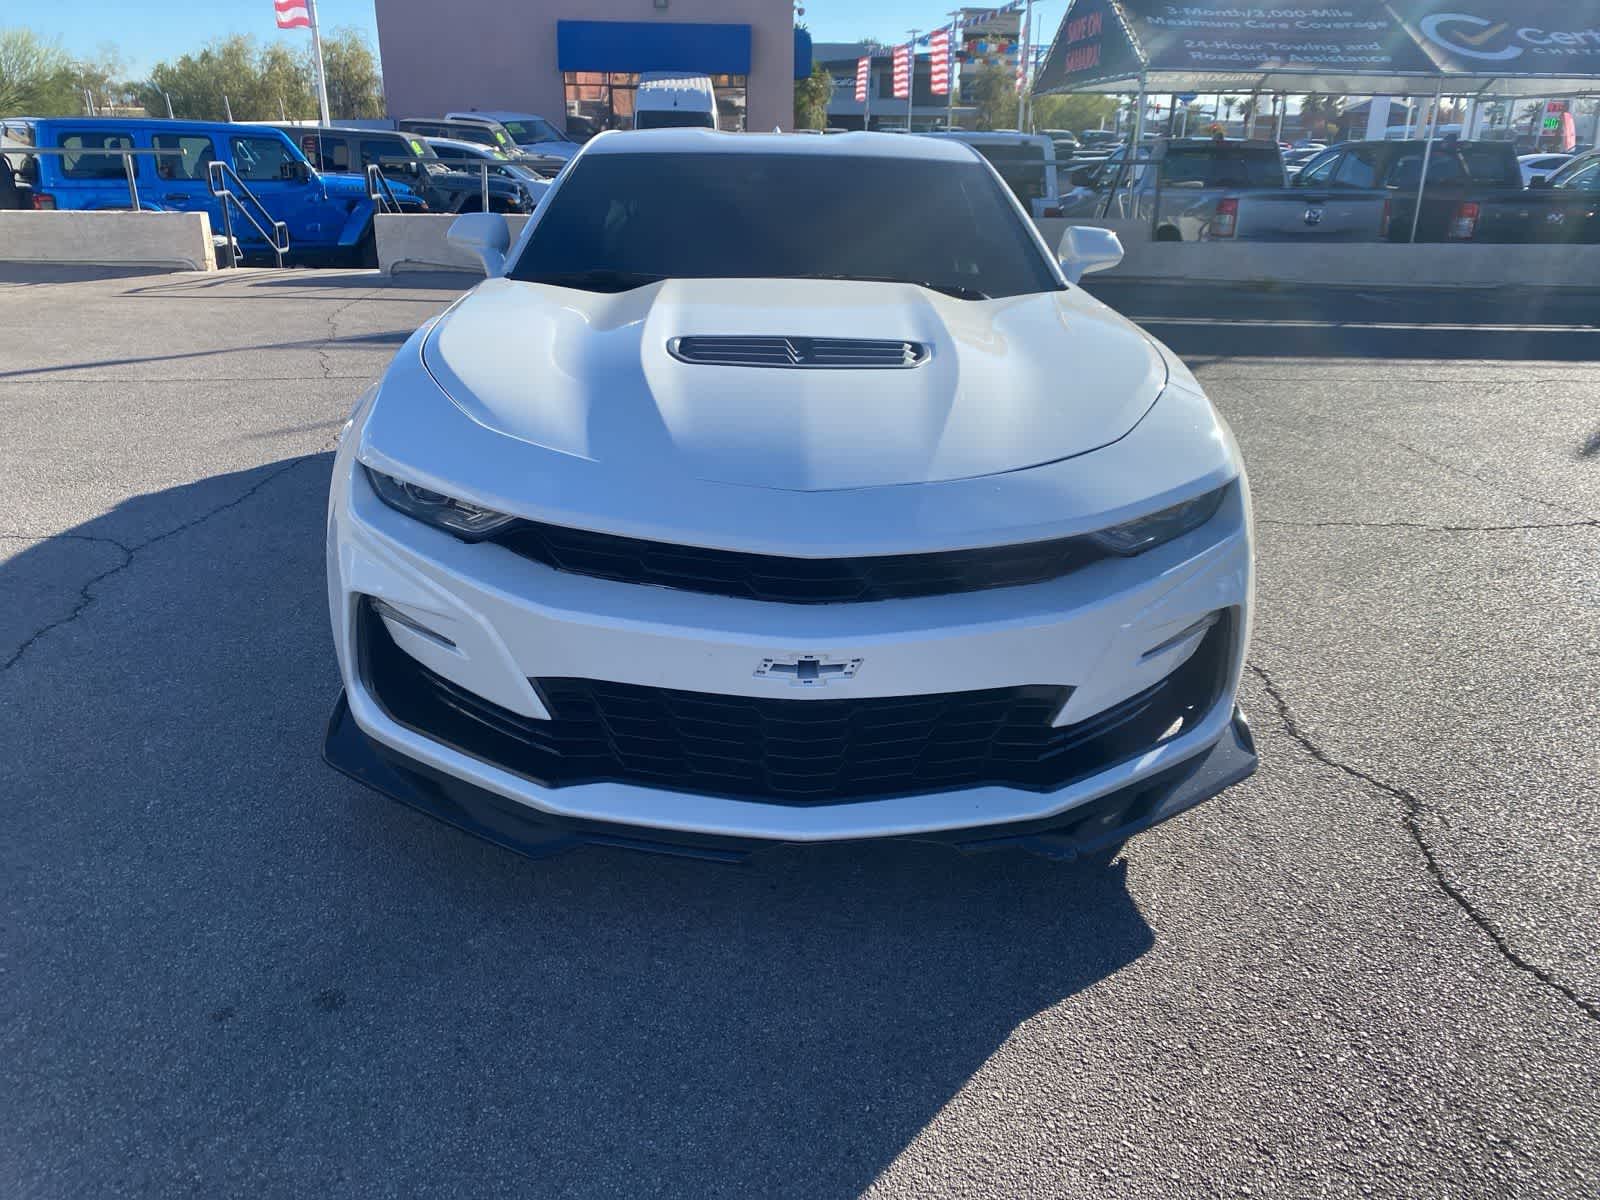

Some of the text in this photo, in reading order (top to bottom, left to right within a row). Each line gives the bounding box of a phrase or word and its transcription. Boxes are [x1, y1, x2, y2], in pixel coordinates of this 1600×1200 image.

[1145, 15, 1388, 31] Maximum Care Coverage
[1184, 39, 1383, 53] 24-Hour Towing and
[1189, 51, 1393, 63] Roadside Assistance
